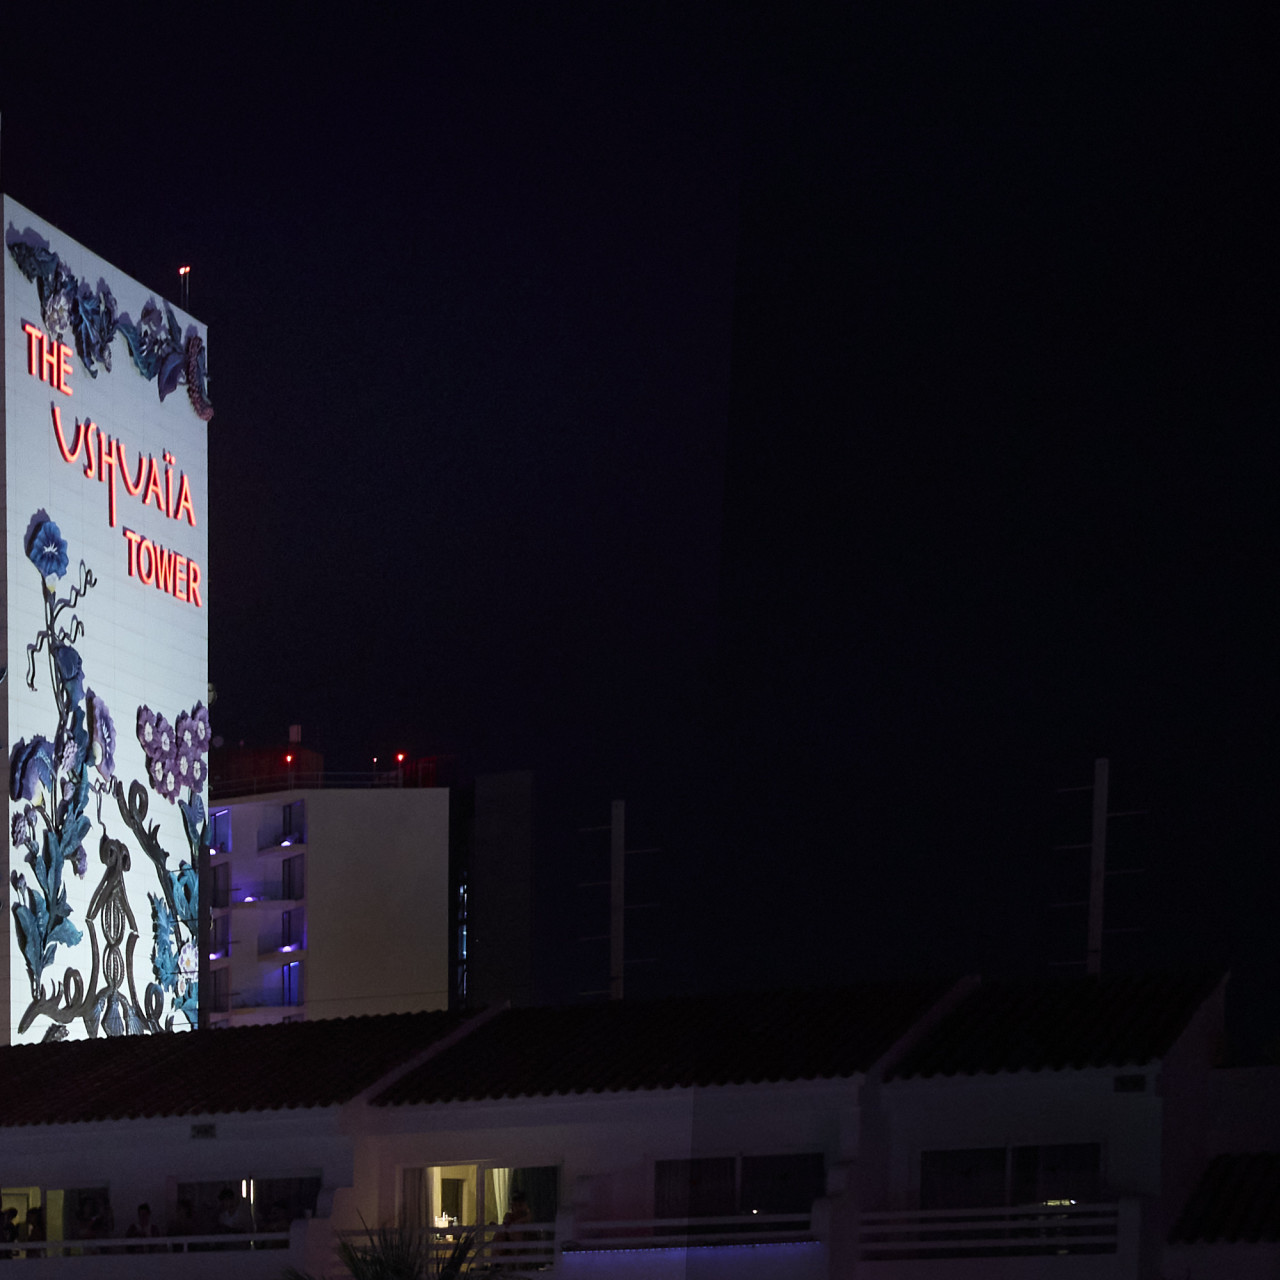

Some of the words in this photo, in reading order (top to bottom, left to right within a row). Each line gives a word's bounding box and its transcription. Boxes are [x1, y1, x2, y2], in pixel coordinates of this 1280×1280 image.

[25, 323, 73, 396] THE
[51, 406, 197, 528] USHUAÏA
[124, 529, 203, 607] TOWER
